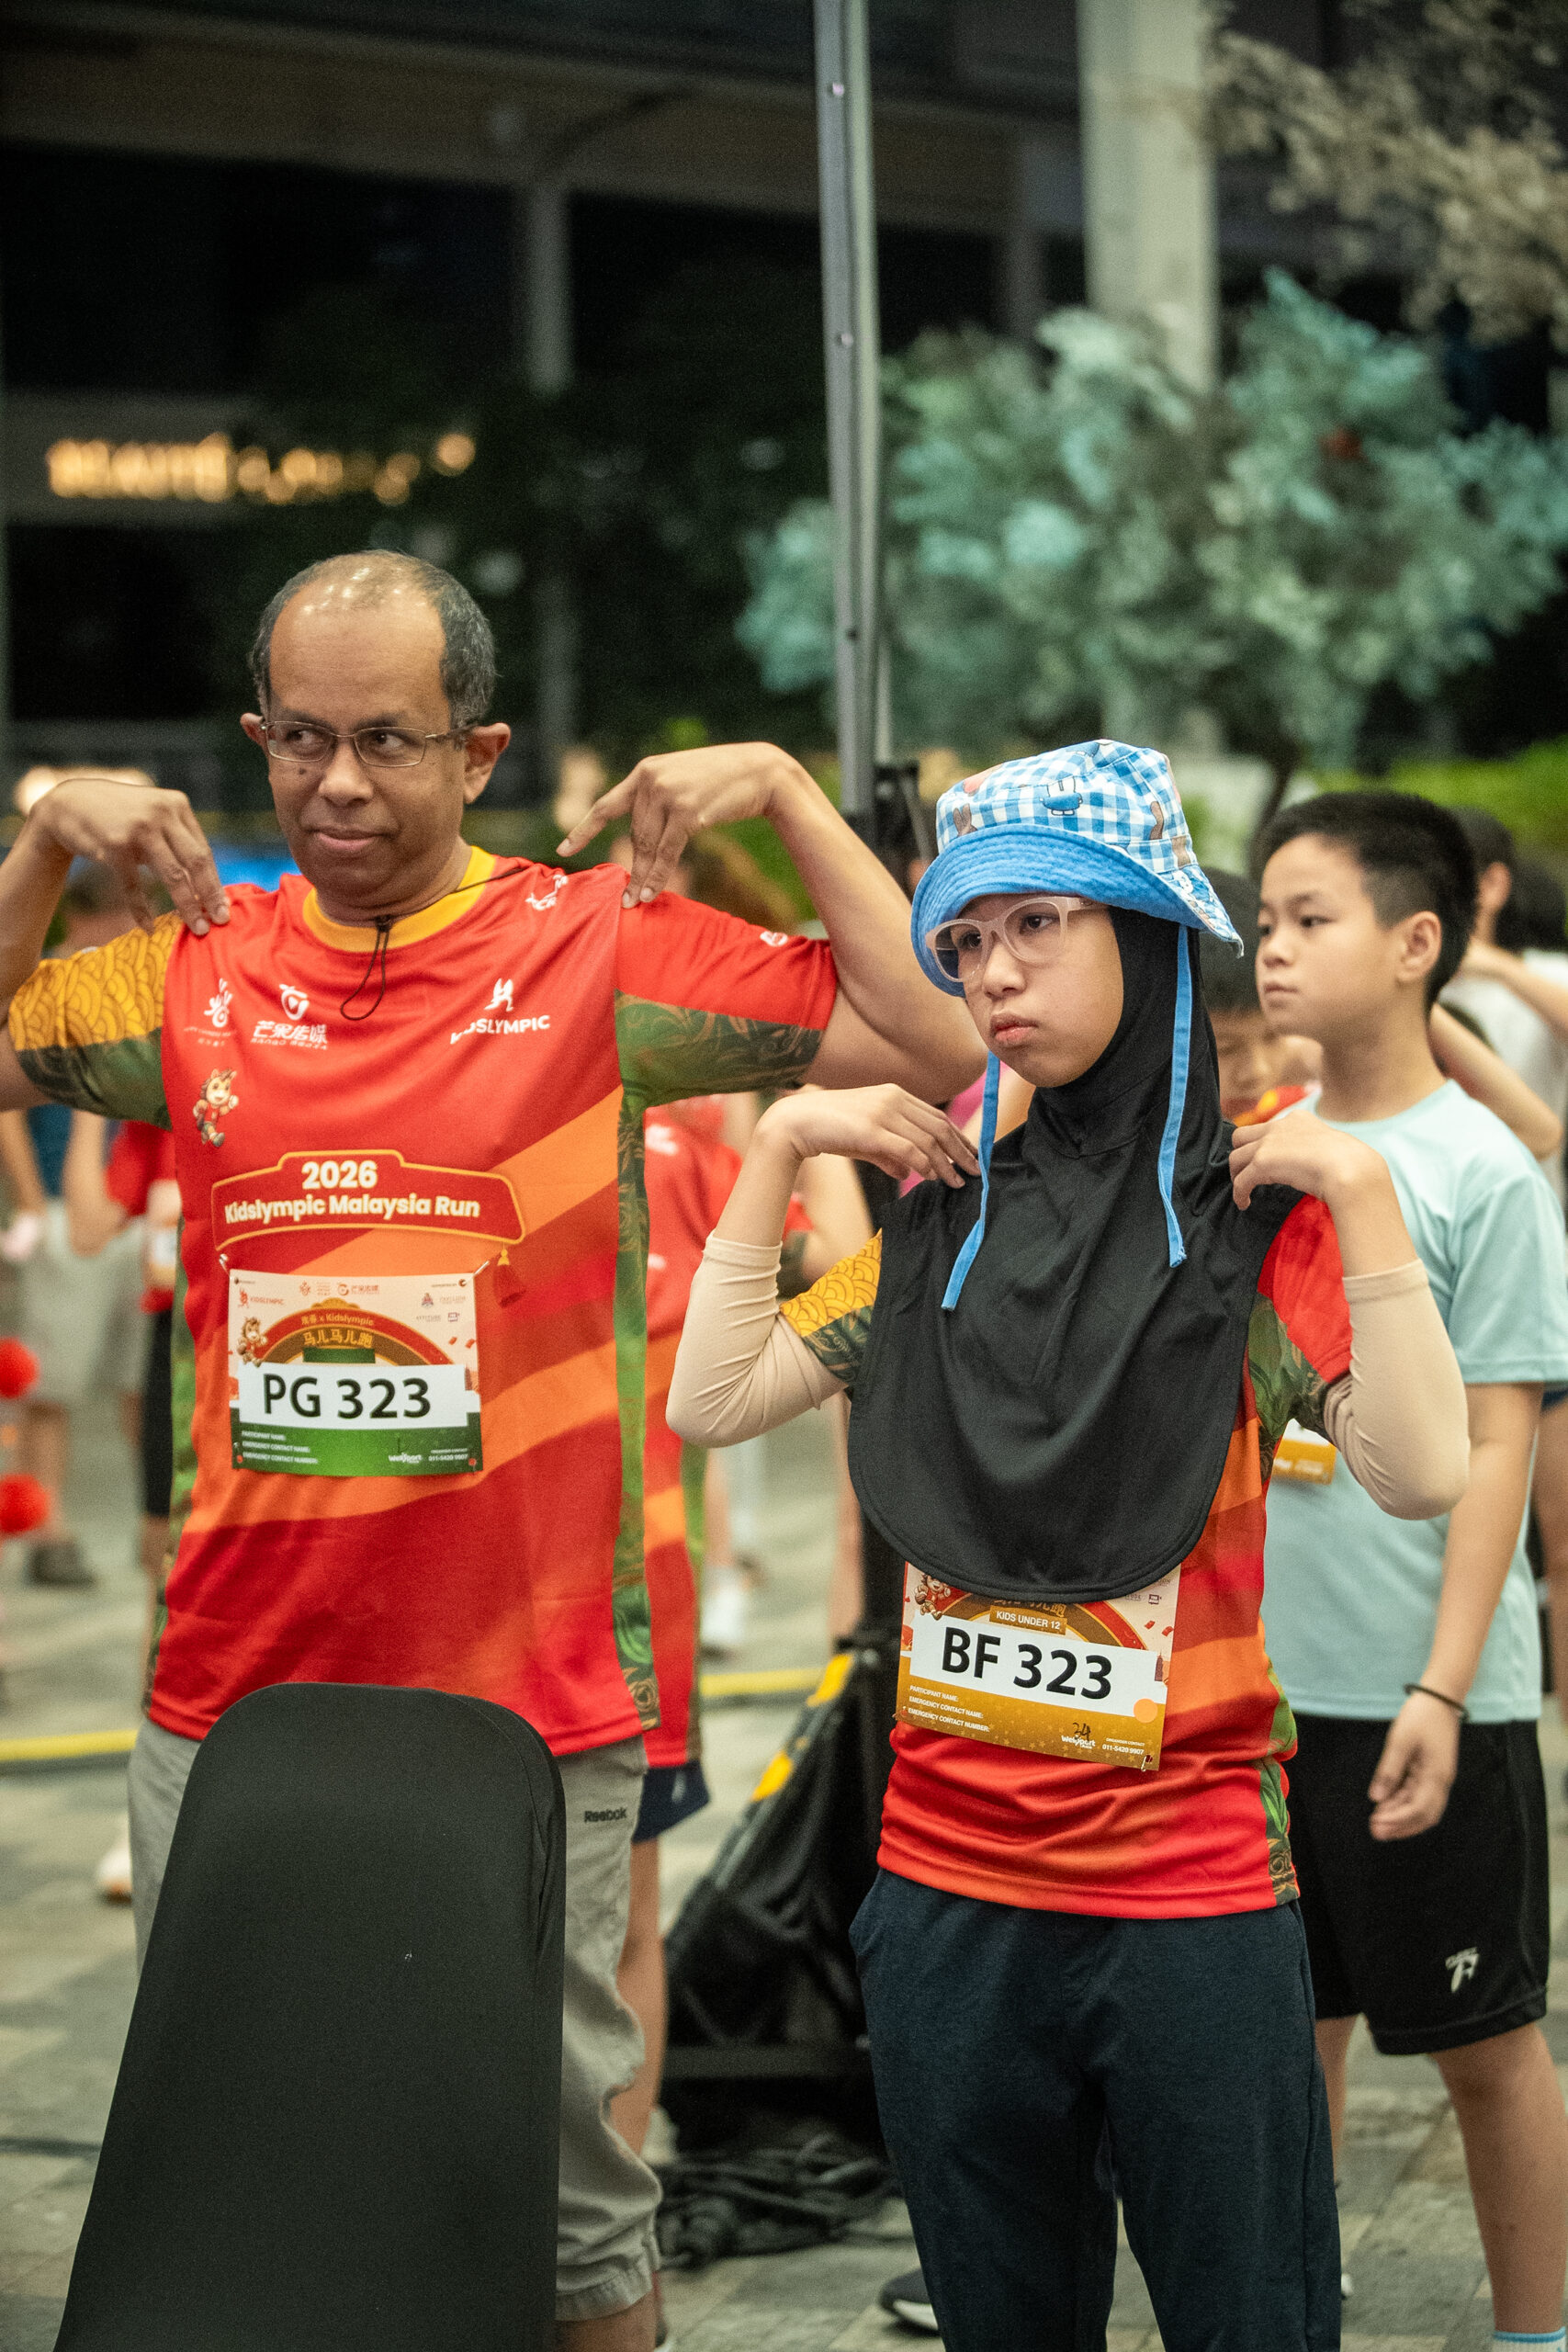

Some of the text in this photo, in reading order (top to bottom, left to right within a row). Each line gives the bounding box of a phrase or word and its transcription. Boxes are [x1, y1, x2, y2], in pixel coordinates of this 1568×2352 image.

[301, 1159, 378, 1190] 2026
[224, 1193, 480, 1225] Kidslympic Malaysia Run
[303, 1329, 373, 1349] 马儿马儿跑
[263, 1373, 432, 1419] PG 323
[996, 1611, 1061, 1630] KIDS UNDER 12
[942, 1626, 1112, 1700] BF 323
[909, 1685, 959, 1702] PARTICIPANT NAME:
[908, 1695, 984, 1719] EMERGENCY CONTACT NAME:
[908, 1707, 990, 1732] EMERGENCY CONTACT NUMBER:
[1101, 1744, 1129, 1753] 011-5420
